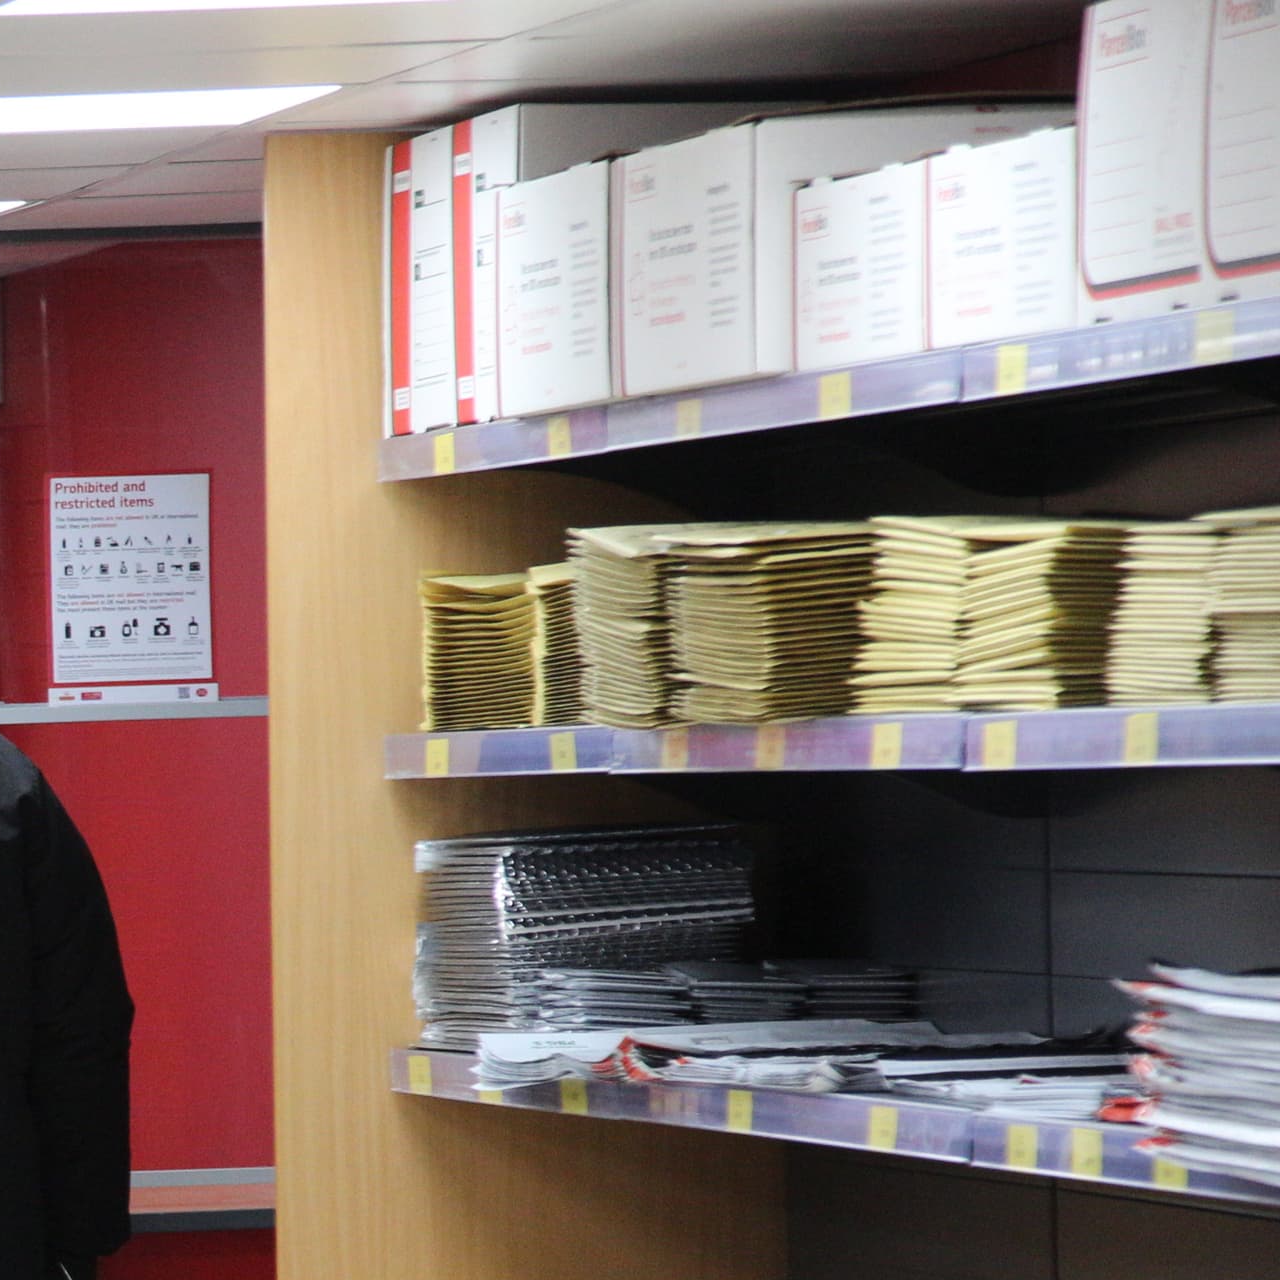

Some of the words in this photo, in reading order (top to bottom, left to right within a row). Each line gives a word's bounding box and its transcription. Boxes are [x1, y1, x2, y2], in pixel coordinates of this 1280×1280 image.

[55, 481, 118, 493] Prohibited
[123, 480, 145, 492] and
[55, 496, 115, 509] restricted
[120, 496, 154, 508] items
